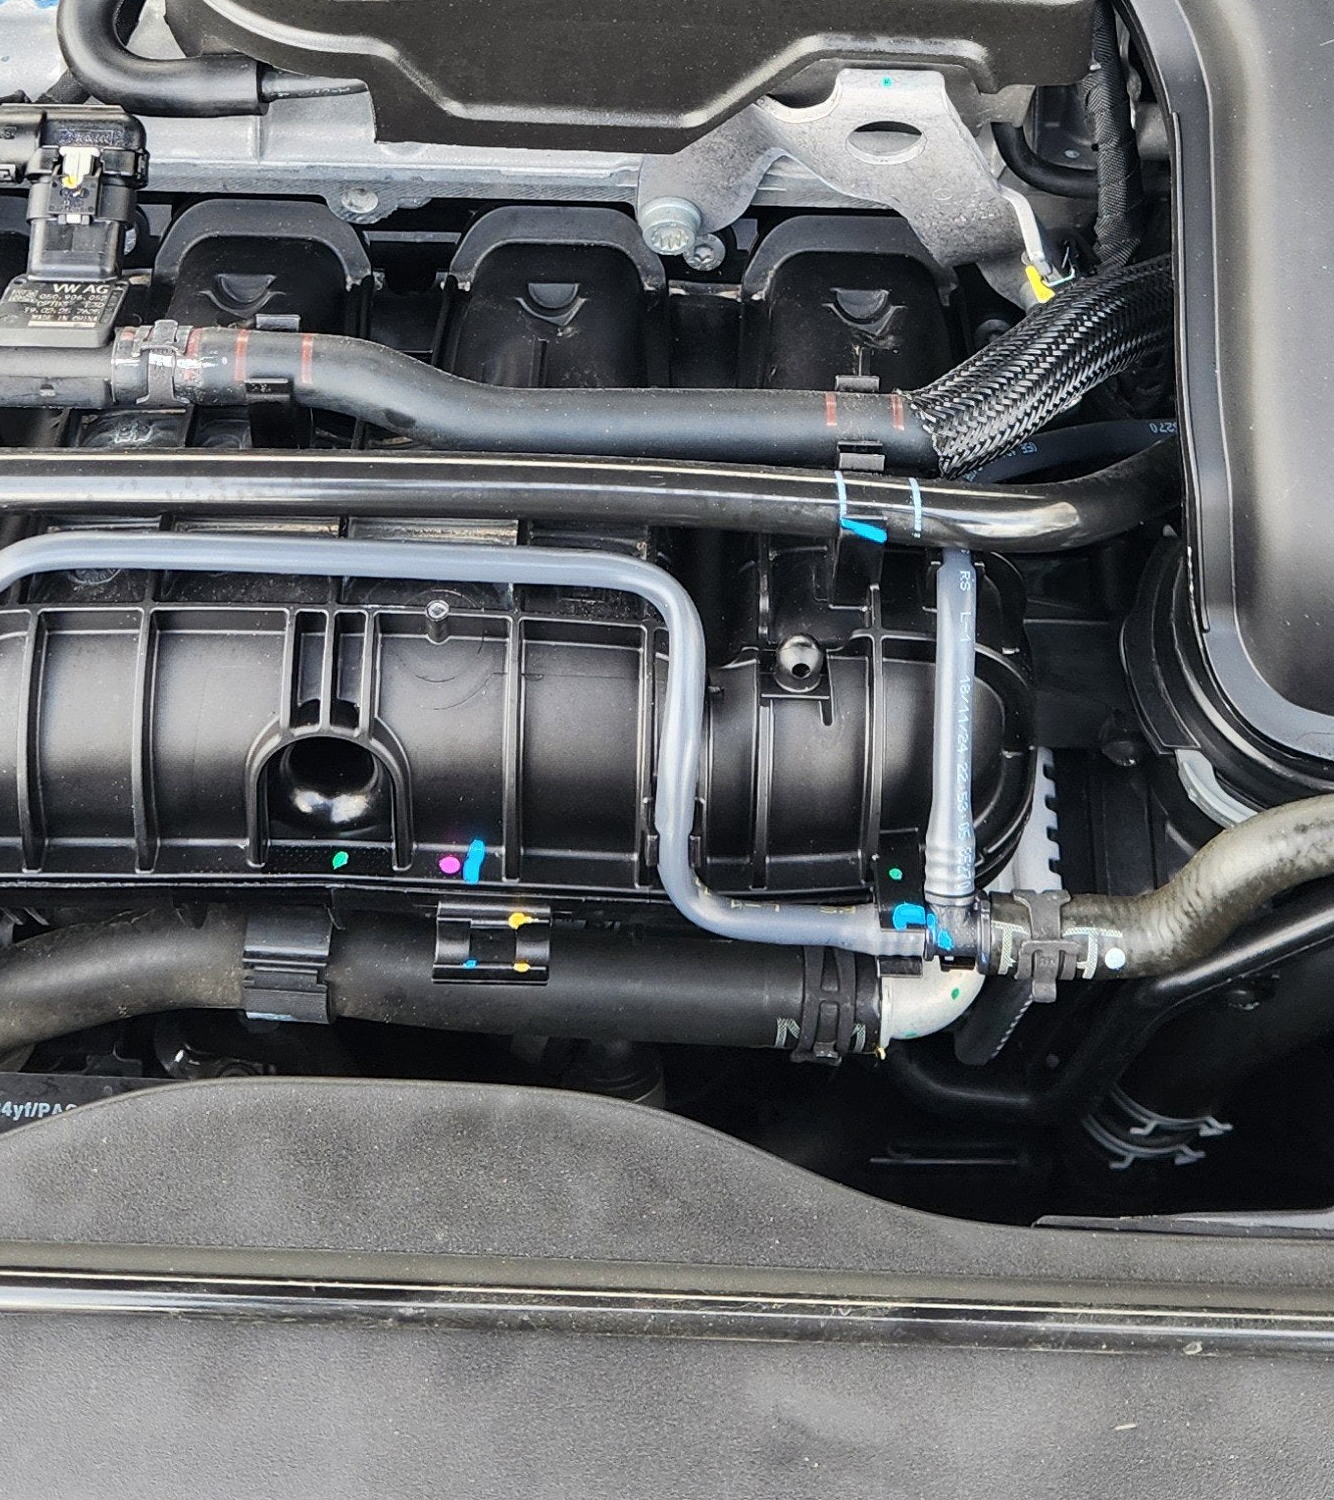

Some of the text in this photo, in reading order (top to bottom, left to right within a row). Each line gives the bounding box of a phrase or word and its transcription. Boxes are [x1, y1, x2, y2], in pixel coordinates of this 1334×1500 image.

[52, 283, 110, 294] VW AG
[959, 570, 971, 592] RS
[958, 674, 971, 754] 18/11/24
